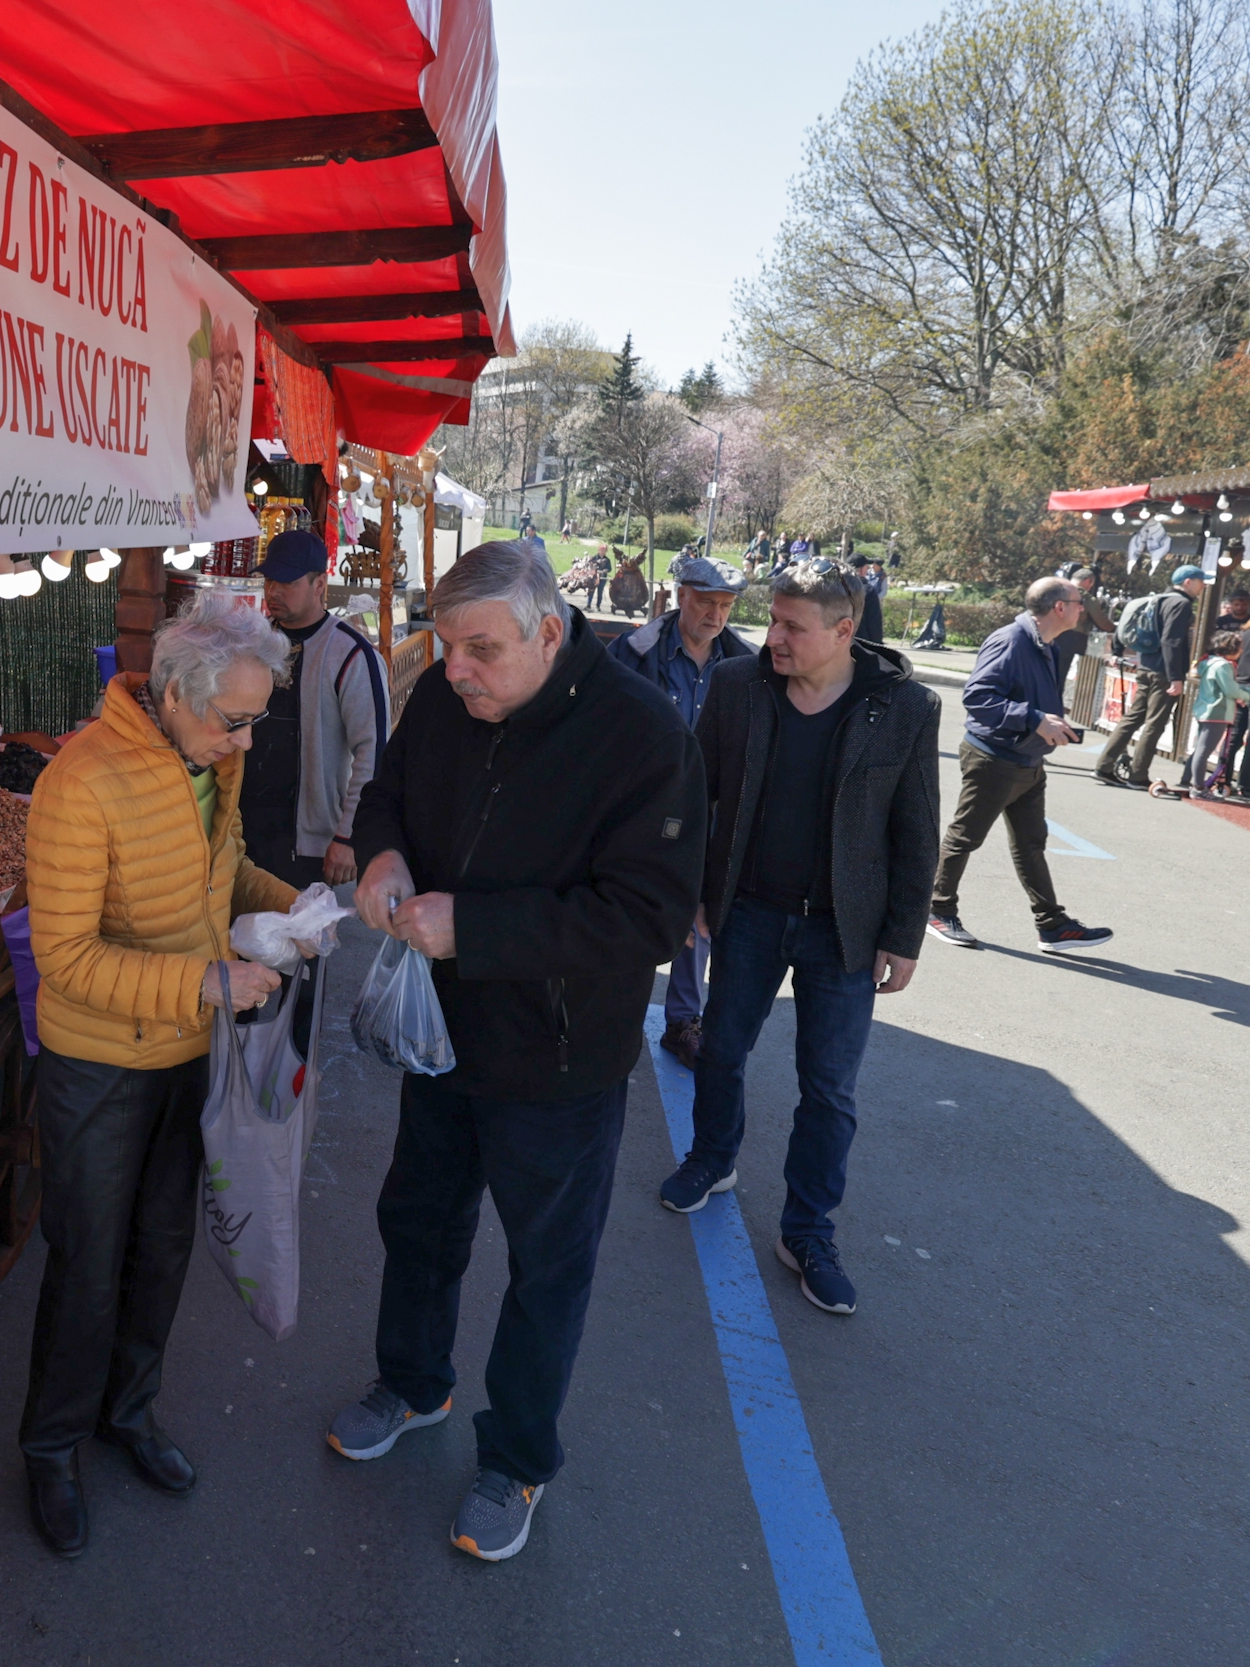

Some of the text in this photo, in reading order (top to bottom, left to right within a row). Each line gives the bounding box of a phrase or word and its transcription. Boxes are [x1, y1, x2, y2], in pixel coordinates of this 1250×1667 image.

[29, 161, 70, 298] DE
[55, 332, 150, 456] USCATE
[94, 484, 123, 526] din
[126, 488, 177, 526] Vrancea
